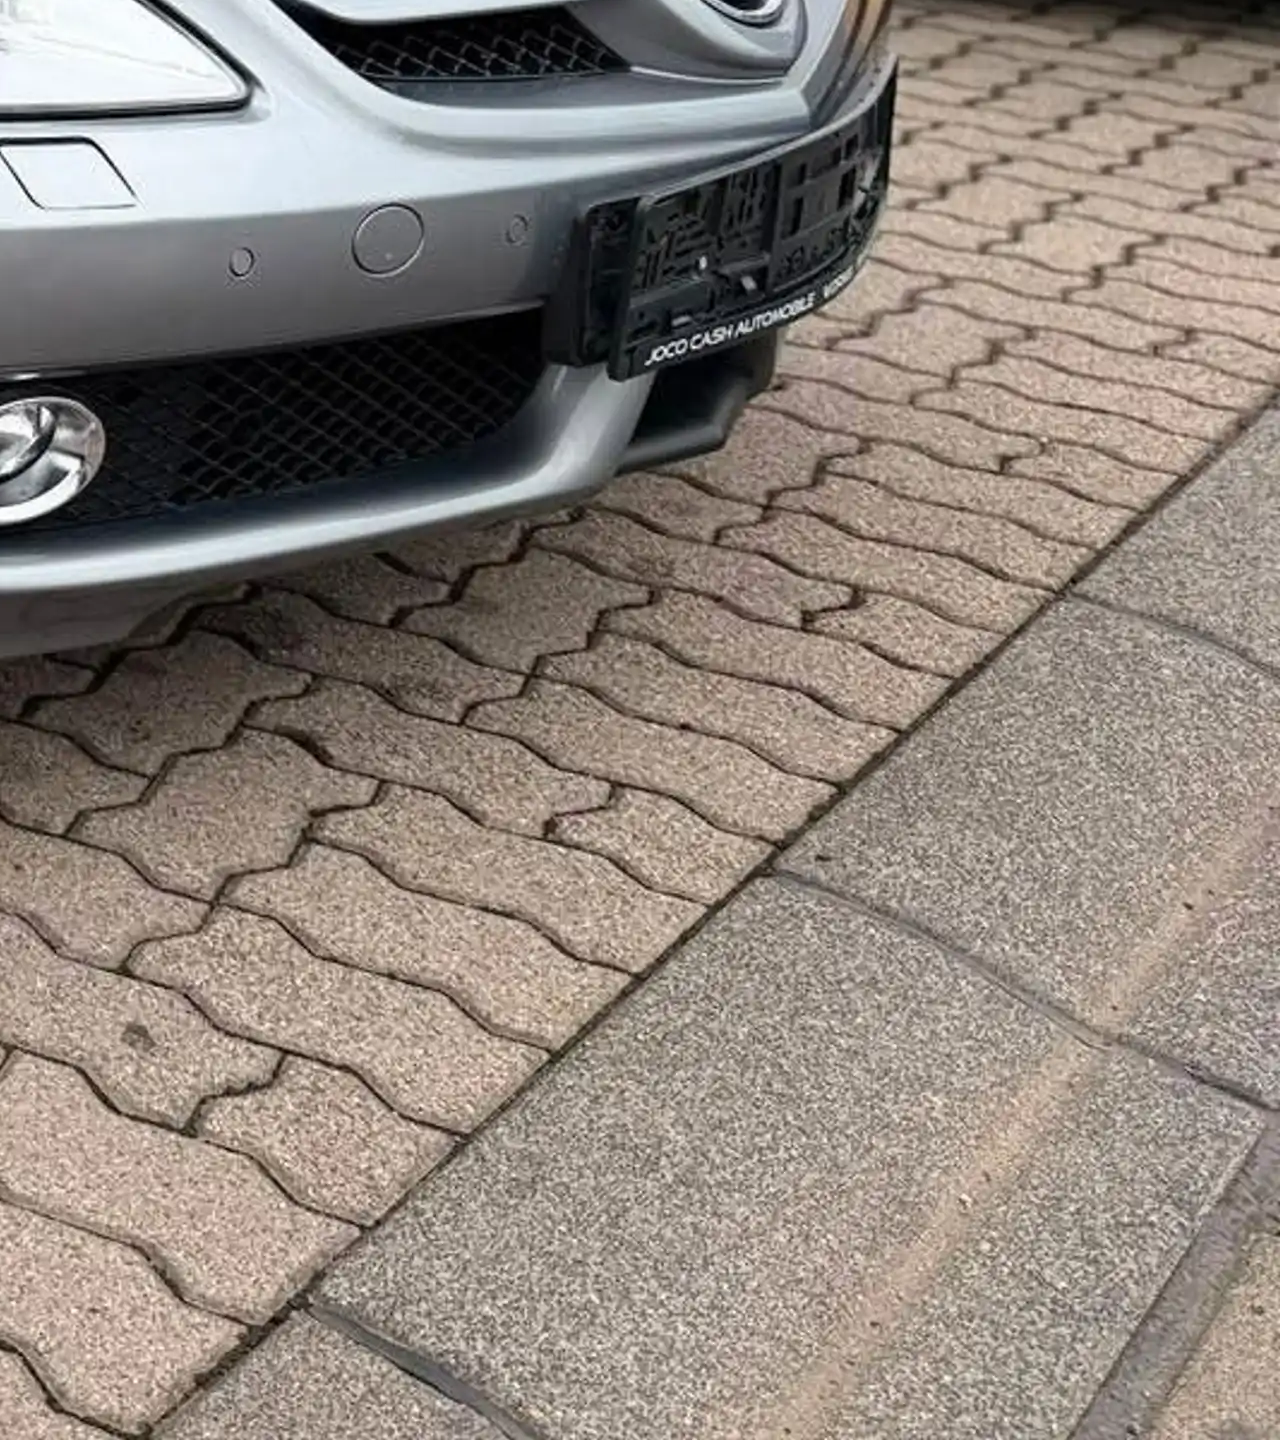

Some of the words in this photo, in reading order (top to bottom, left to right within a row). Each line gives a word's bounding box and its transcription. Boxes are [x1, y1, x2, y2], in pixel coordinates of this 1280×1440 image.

[644, 337, 689, 366] JOCO
[690, 323, 734, 350] CASH
[735, 291, 816, 339] AUTOMOBILE
